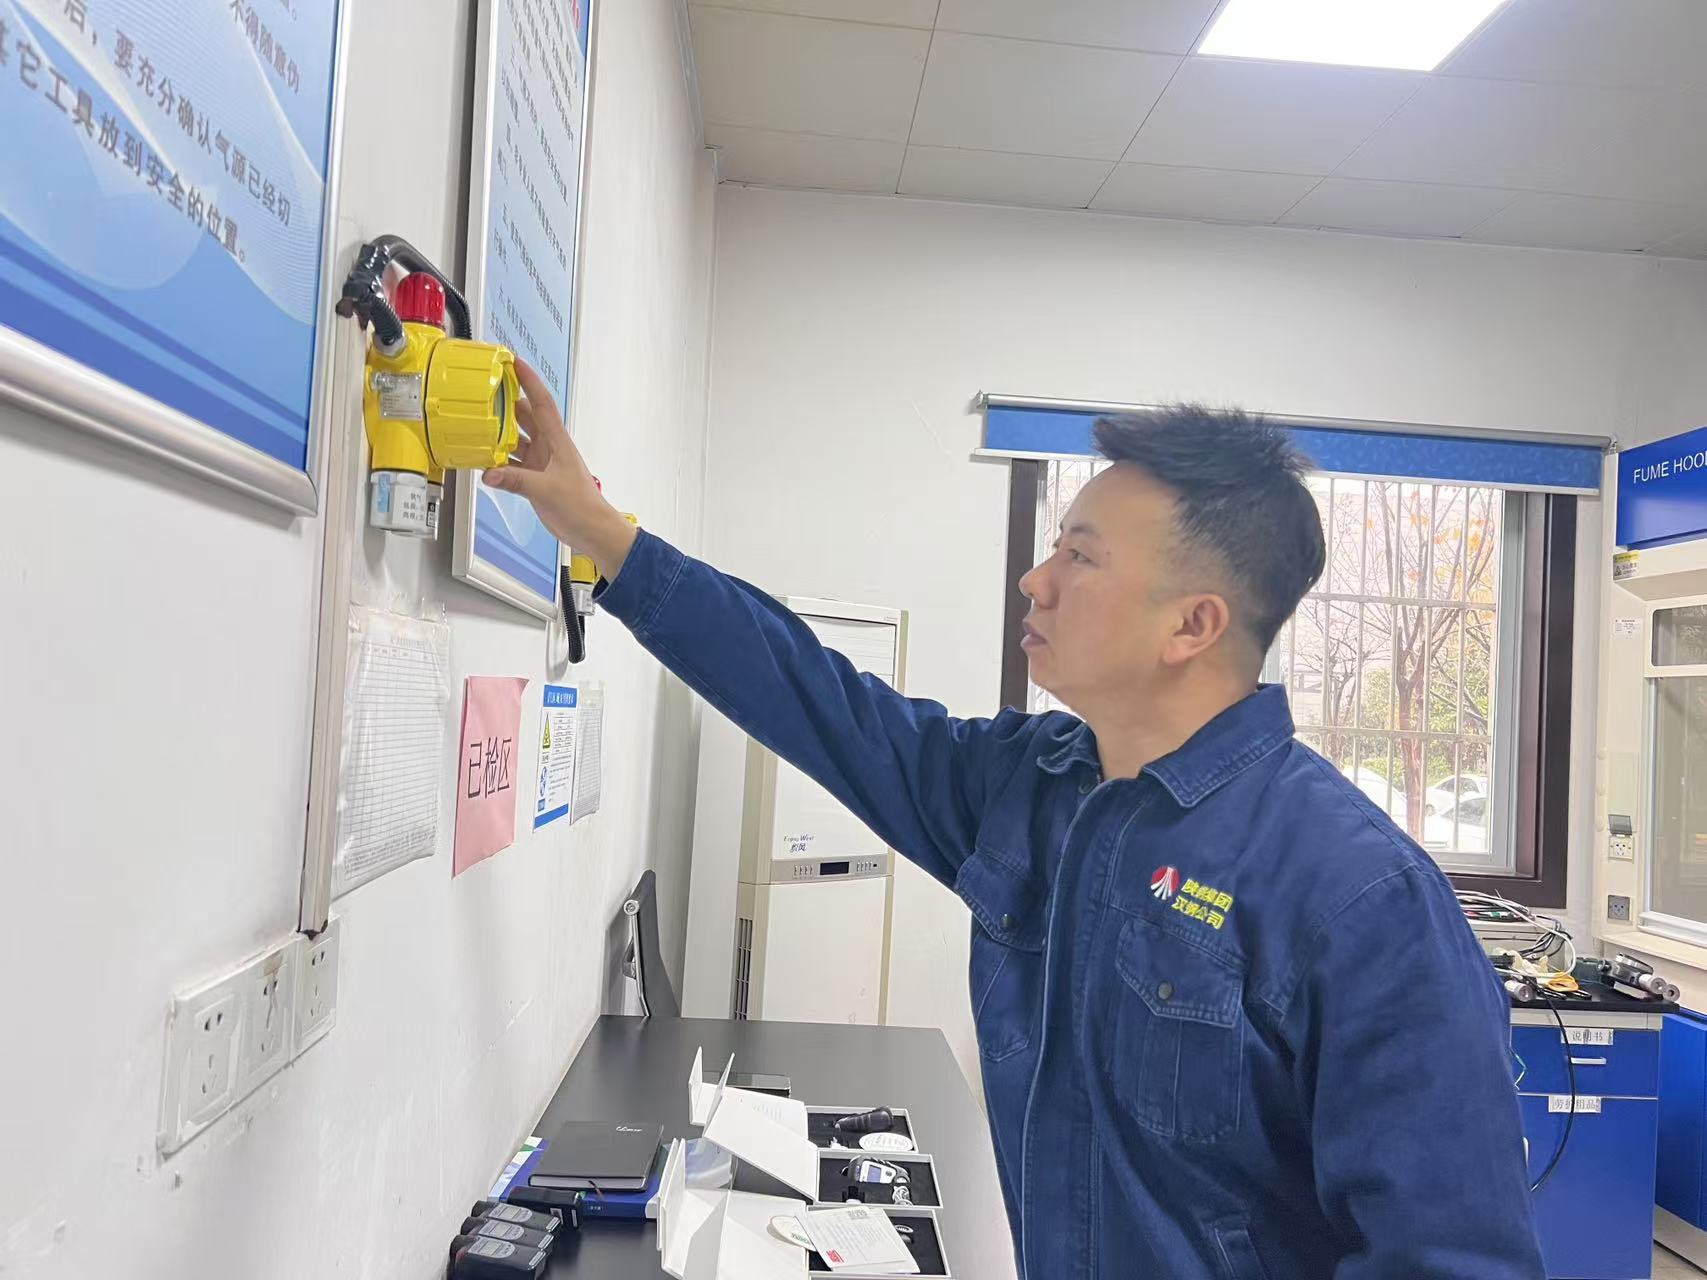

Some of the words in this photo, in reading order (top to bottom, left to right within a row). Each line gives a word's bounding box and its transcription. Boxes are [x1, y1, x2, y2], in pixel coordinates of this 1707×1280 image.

[1633, 461, 1669, 484] FUME
[468, 736, 512, 799] 已检区
